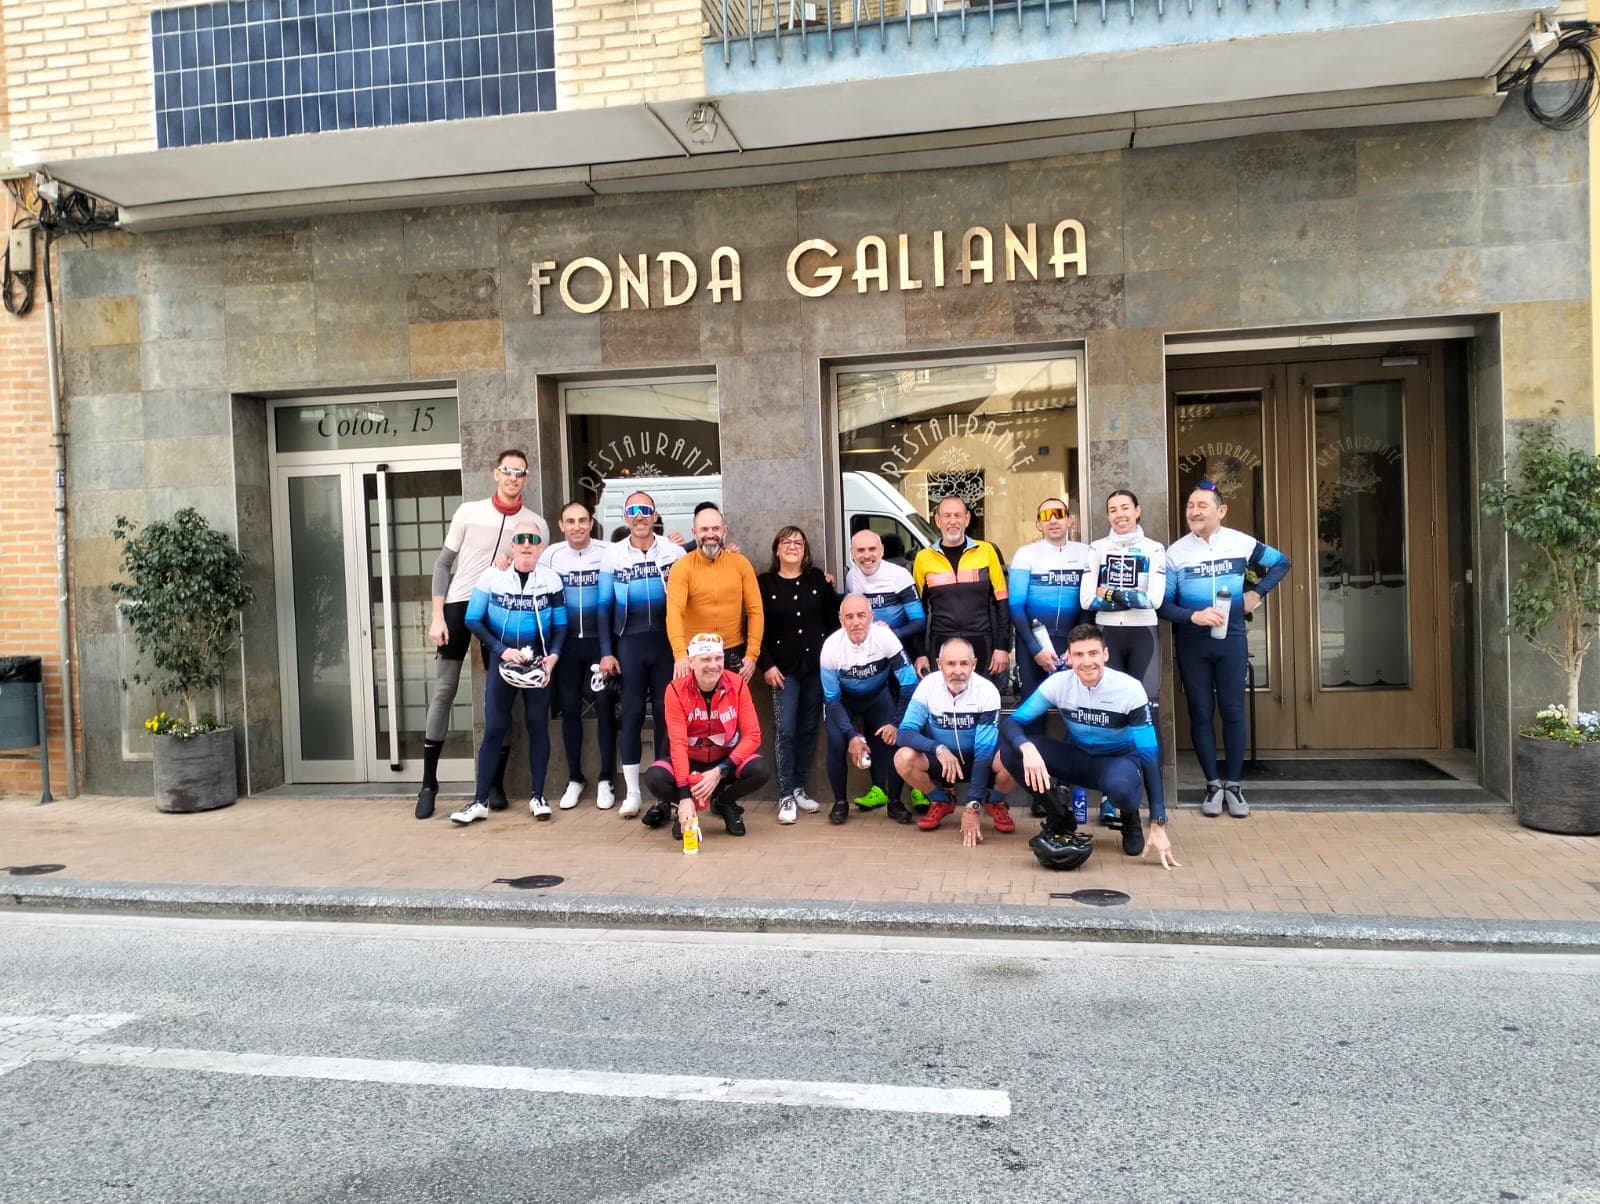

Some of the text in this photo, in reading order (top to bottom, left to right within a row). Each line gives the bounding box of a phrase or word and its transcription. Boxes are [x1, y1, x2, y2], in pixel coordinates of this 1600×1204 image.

[529, 218, 1088, 315] FONDA GALIANA
[410, 406, 436, 432] 15
[578, 431, 713, 493] RESTAURANT
[881, 414, 1034, 478] RESTAURANTE
[1179, 442, 1261, 474] RESTAURANTE
[1315, 436, 1402, 468] RESTAURANTE
